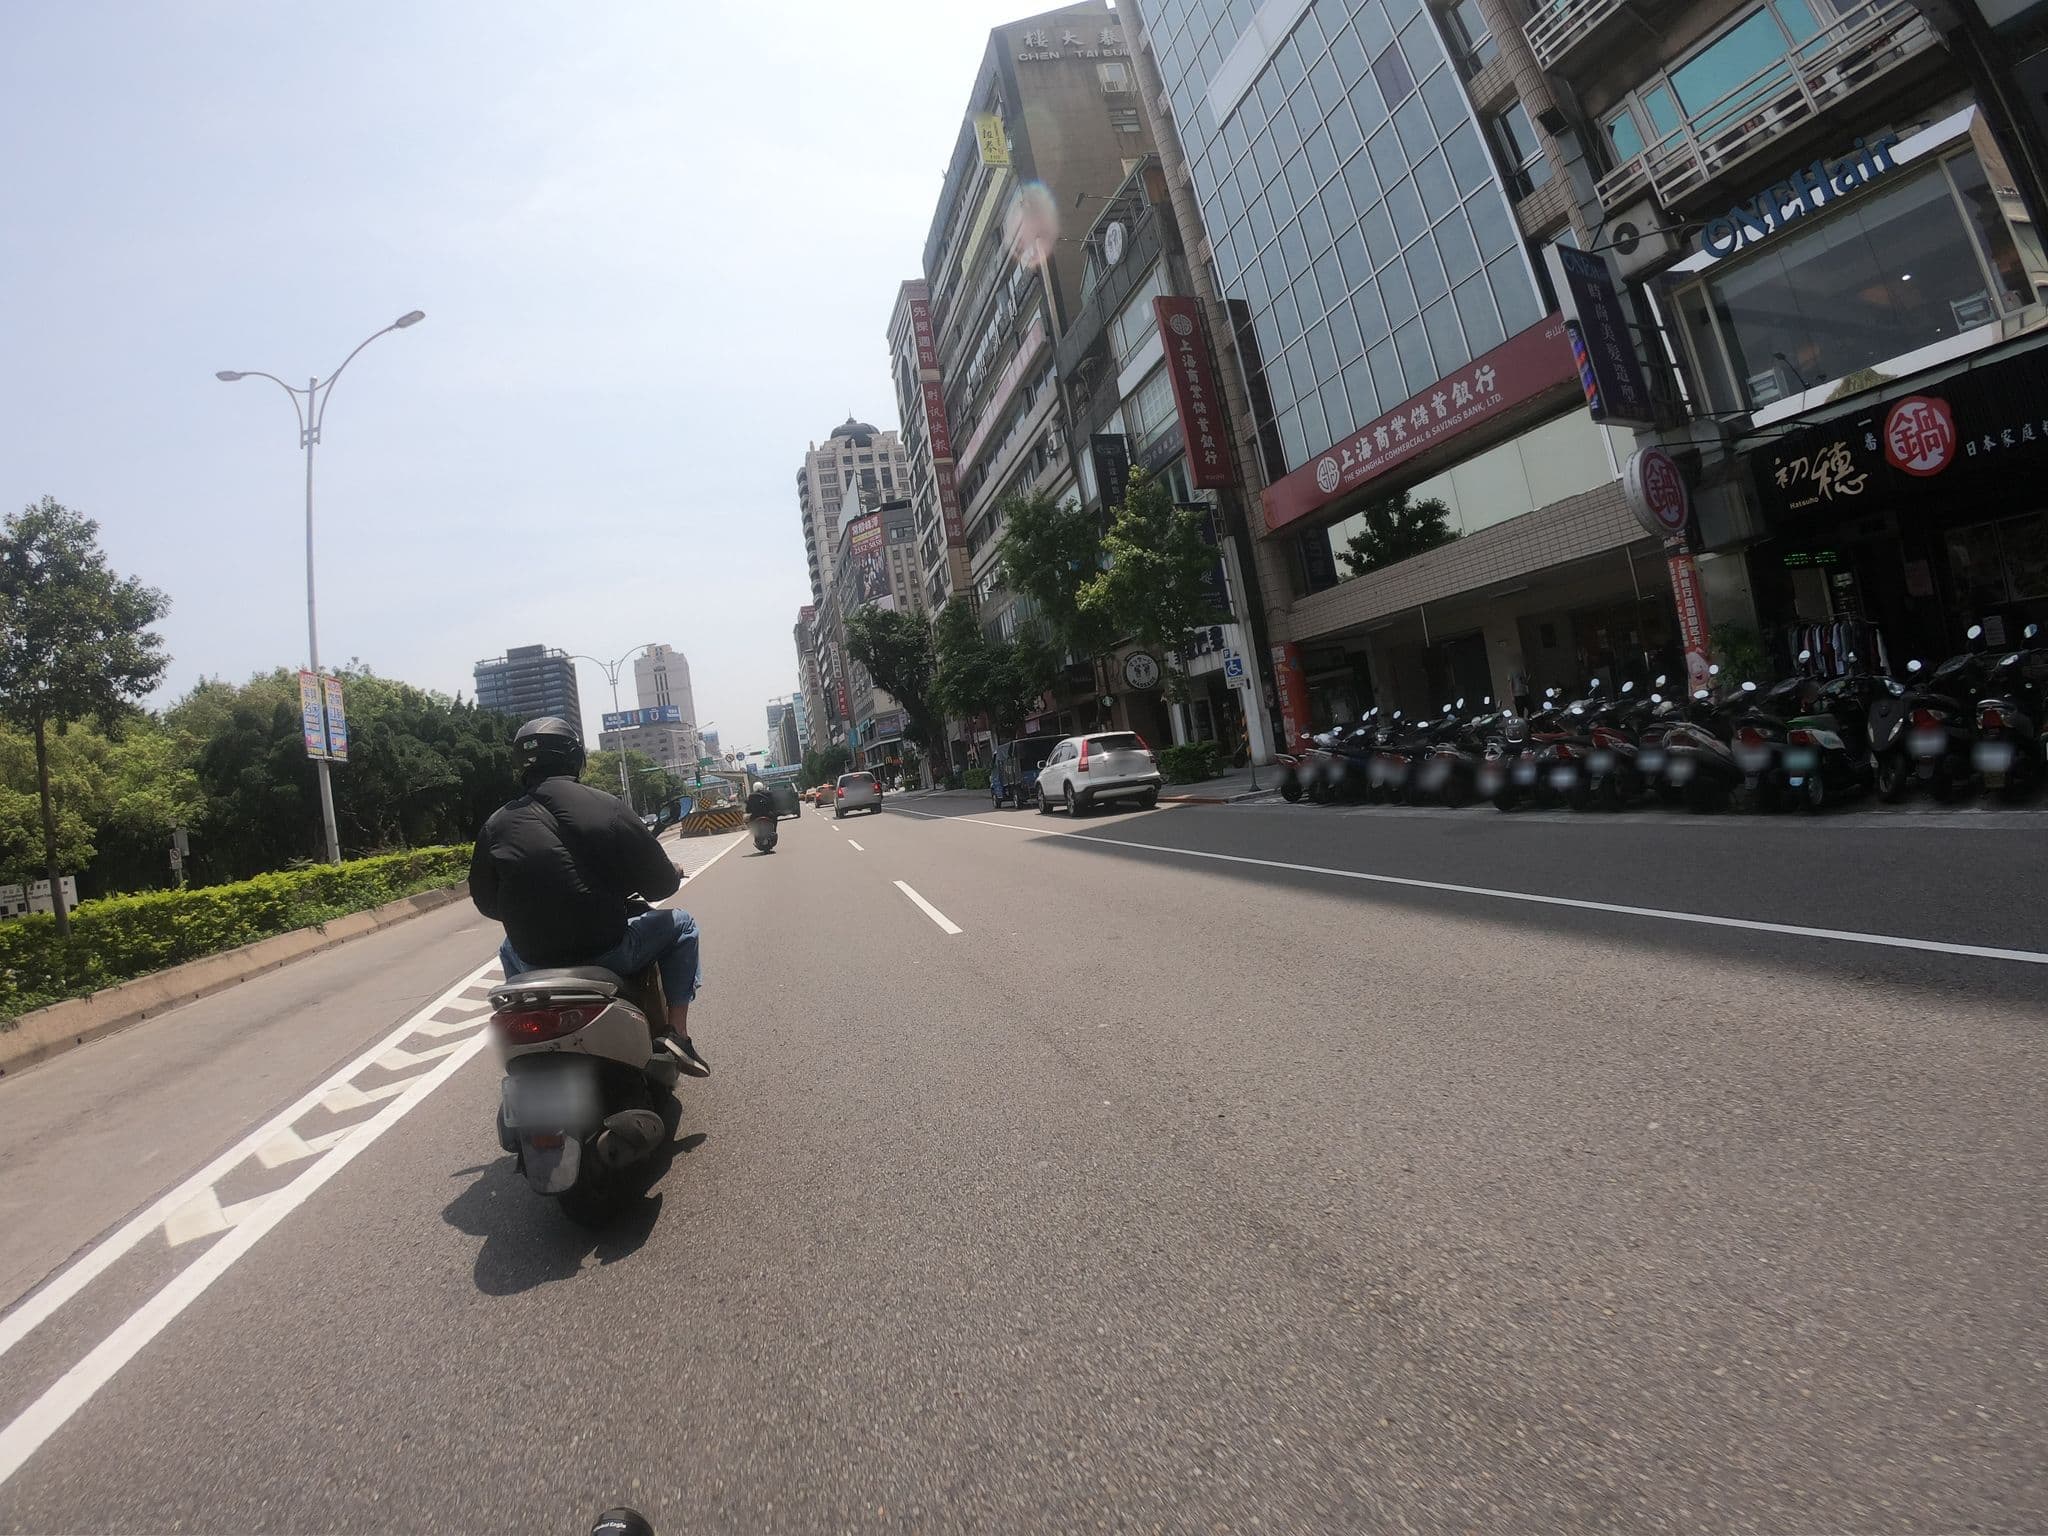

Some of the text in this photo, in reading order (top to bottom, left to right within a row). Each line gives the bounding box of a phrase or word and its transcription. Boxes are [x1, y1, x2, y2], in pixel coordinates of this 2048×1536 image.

[1018, 52, 1060, 61] CHEN
[1073, 49, 1098, 58] TAI
[1179, 339, 1217, 465] 上海商業儲蓄銀行
[1341, 364, 1496, 472] 上海商業儲蓄銀行
[1343, 473, 1355, 485] THE
[1355, 455, 1384, 477] SHANGHAI
[1384, 435, 1425, 462] COMMERCIAL
[1432, 415, 1462, 437] SAVINGS
[1487, 393, 1504, 408] LTD.
[1858, 418, 1878, 450] 一番
[1888, 402, 1950, 466] 鍋
